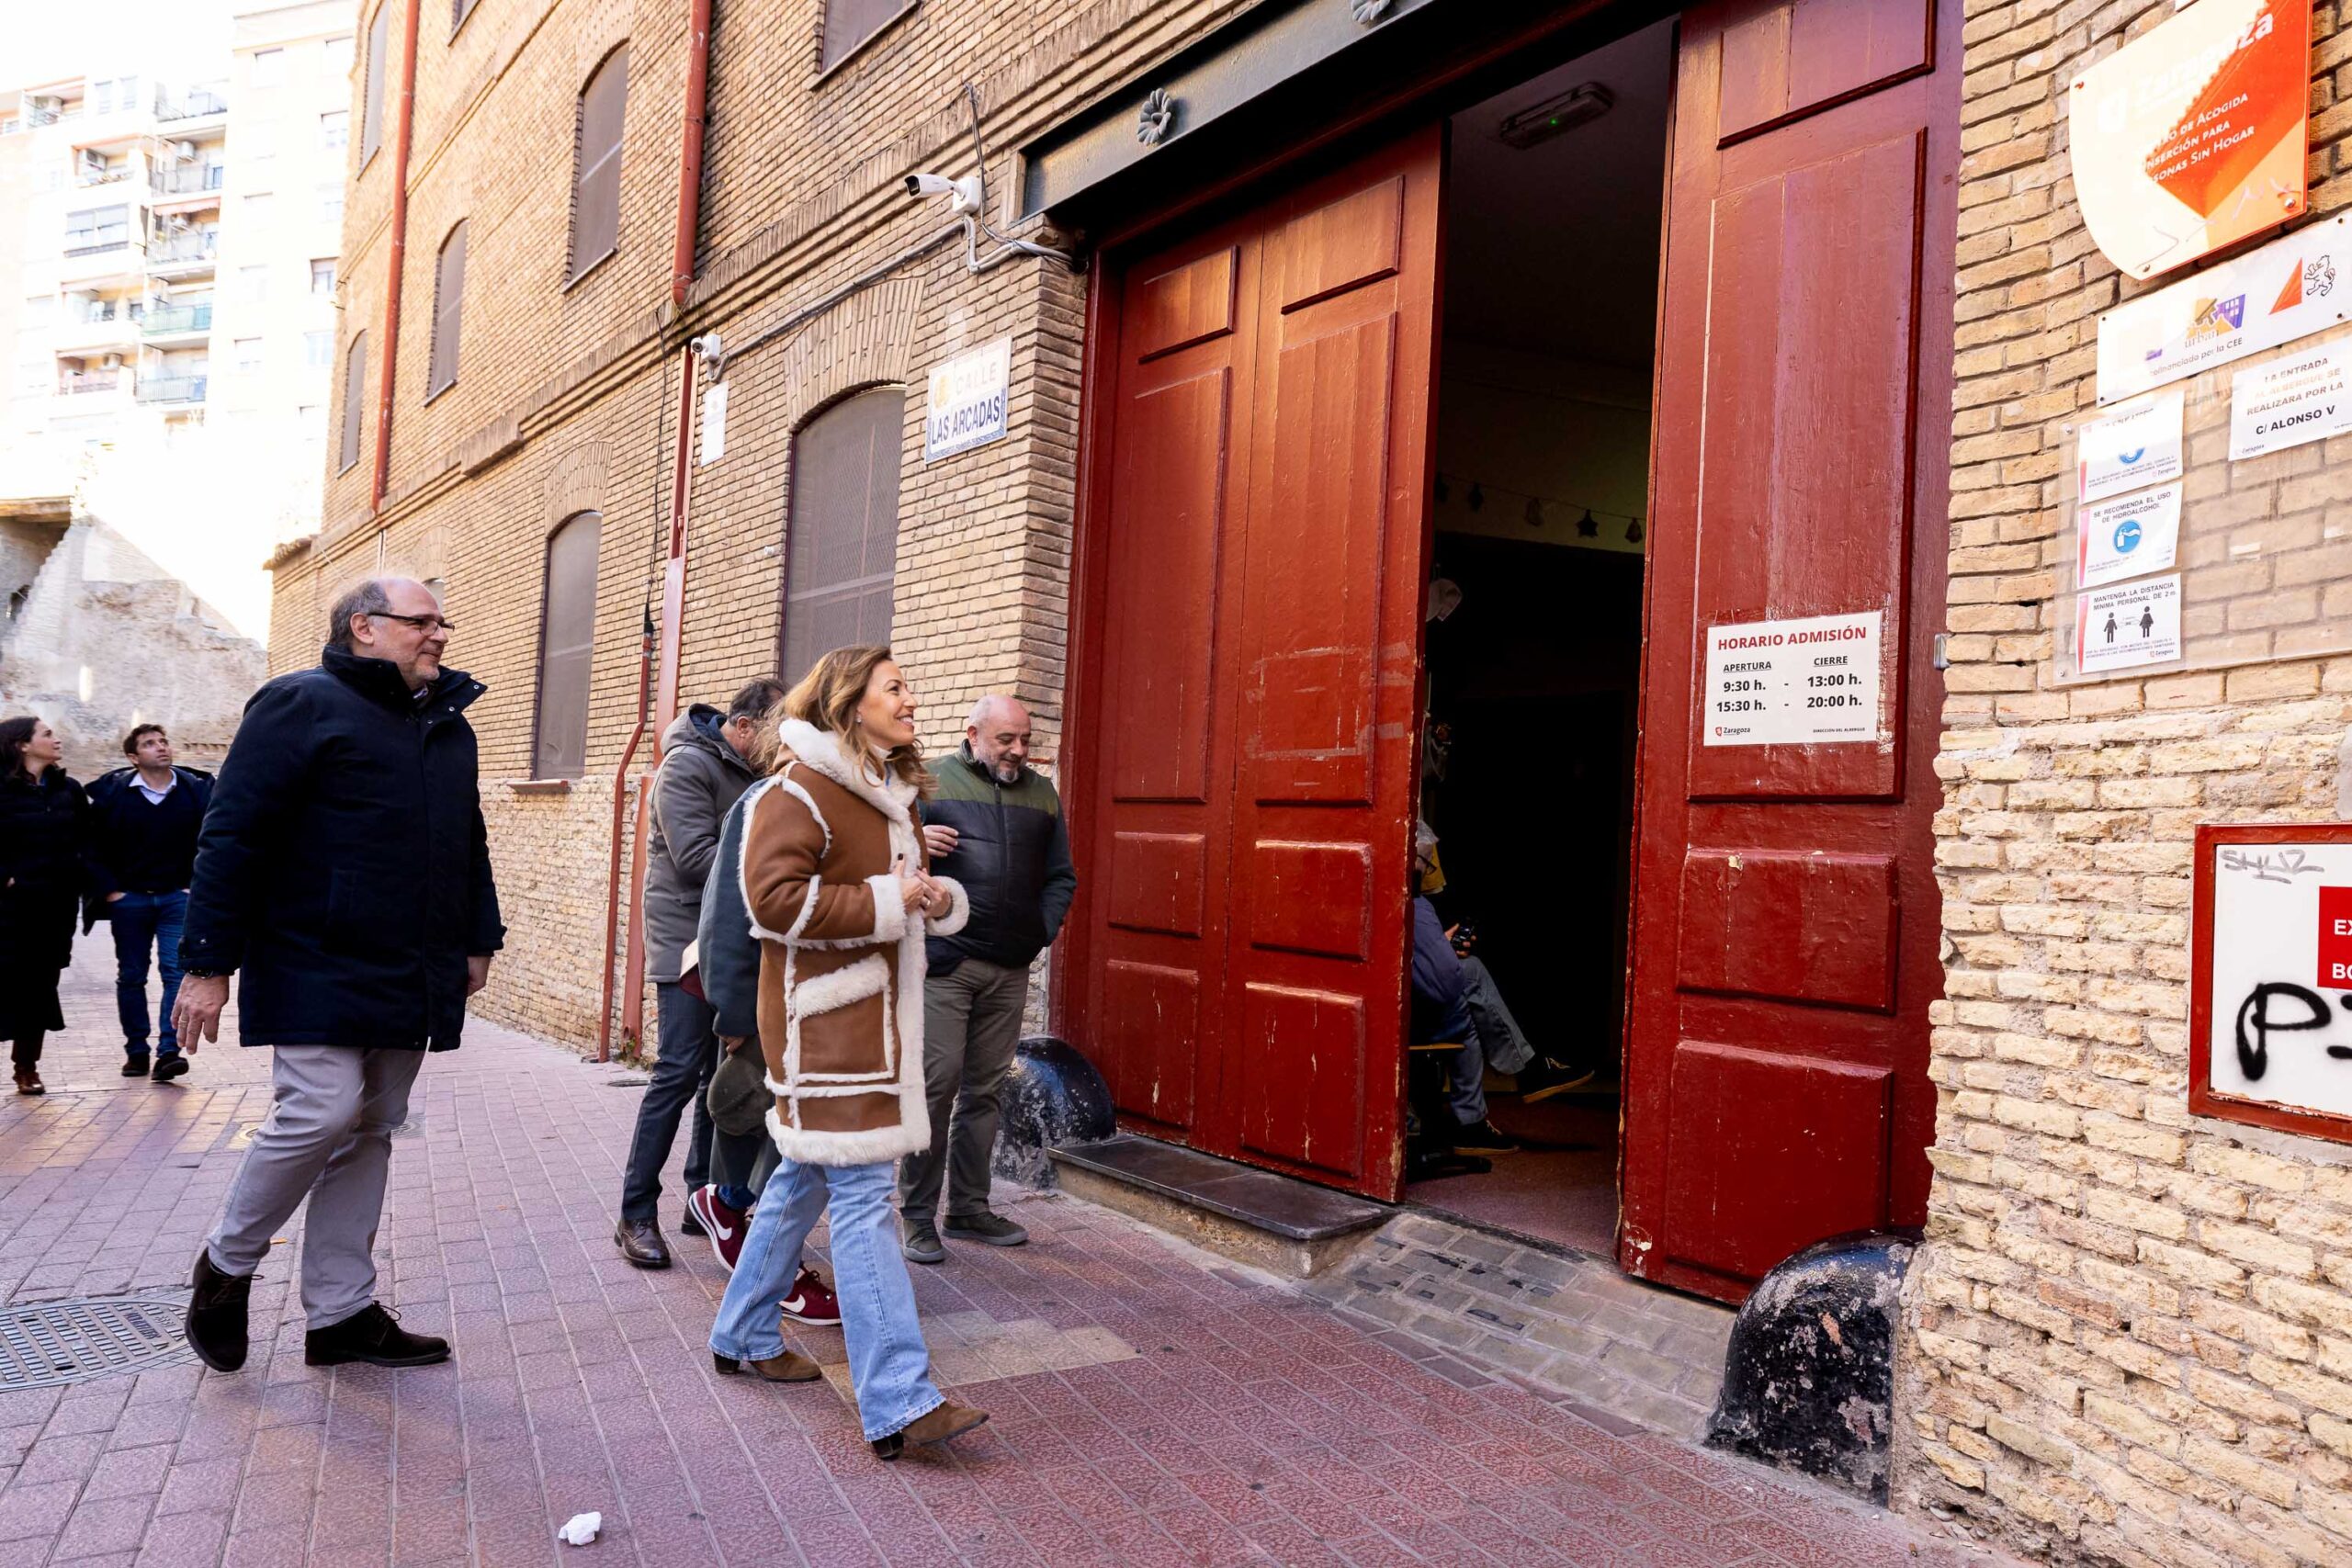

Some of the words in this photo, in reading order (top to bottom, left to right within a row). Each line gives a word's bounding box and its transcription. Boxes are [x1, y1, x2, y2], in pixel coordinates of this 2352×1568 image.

[2180, 120, 2194, 135] DE
[2197, 93, 2248, 127] ACOGIDA
[2146, 135, 2199, 170] NSERCIÓN
[2202, 120, 2231, 141] PARA
[2153, 159, 2188, 183] SONAS
[2190, 147, 2211, 164] SIN
[2213, 125, 2255, 153] HOGAR
[2216, 344, 2224, 353] la
[2226, 337, 2243, 349] CEE
[2280, 357, 2329, 378] ENTRADA
[2326, 367, 2342, 378] SE
[2246, 393, 2302, 416] REALIZARA
[2305, 386, 2327, 399] POR
[2330, 381, 2344, 391] LA
[931, 414, 950, 445] LAS
[952, 395, 1000, 438] ARCADAS
[2256, 423, 2267, 435] C/
[2270, 409, 2323, 432] ALONSO
[2326, 405, 2336, 415] V
[2103, 499, 2143, 514] RECOMIENDA
[2157, 491, 2171, 501] USO
[2094, 592, 2127, 603] MANTENGA
[2140, 582, 2175, 593] DISTANCIA
[2117, 594, 2151, 606] PERSONAL
[1717, 634, 1783, 650] HORARIO
[1787, 626, 1867, 645] ADMISIÓN
[1723, 660, 1772, 672] APERTURA
[1814, 655, 1849, 666] CIERRE
[1723, 680, 1750, 693] 9:30
[1754, 680, 1767, 691] h.
[1807, 674, 1845, 687] 13:00
[1849, 673, 1862, 685] h.
[1716, 700, 1750, 713] 15:30
[1754, 699, 1767, 711] h.
[1806, 695, 1845, 708] 20:00
[1849, 694, 1862, 706] h.
[1723, 727, 1751, 736] Zaragoza
